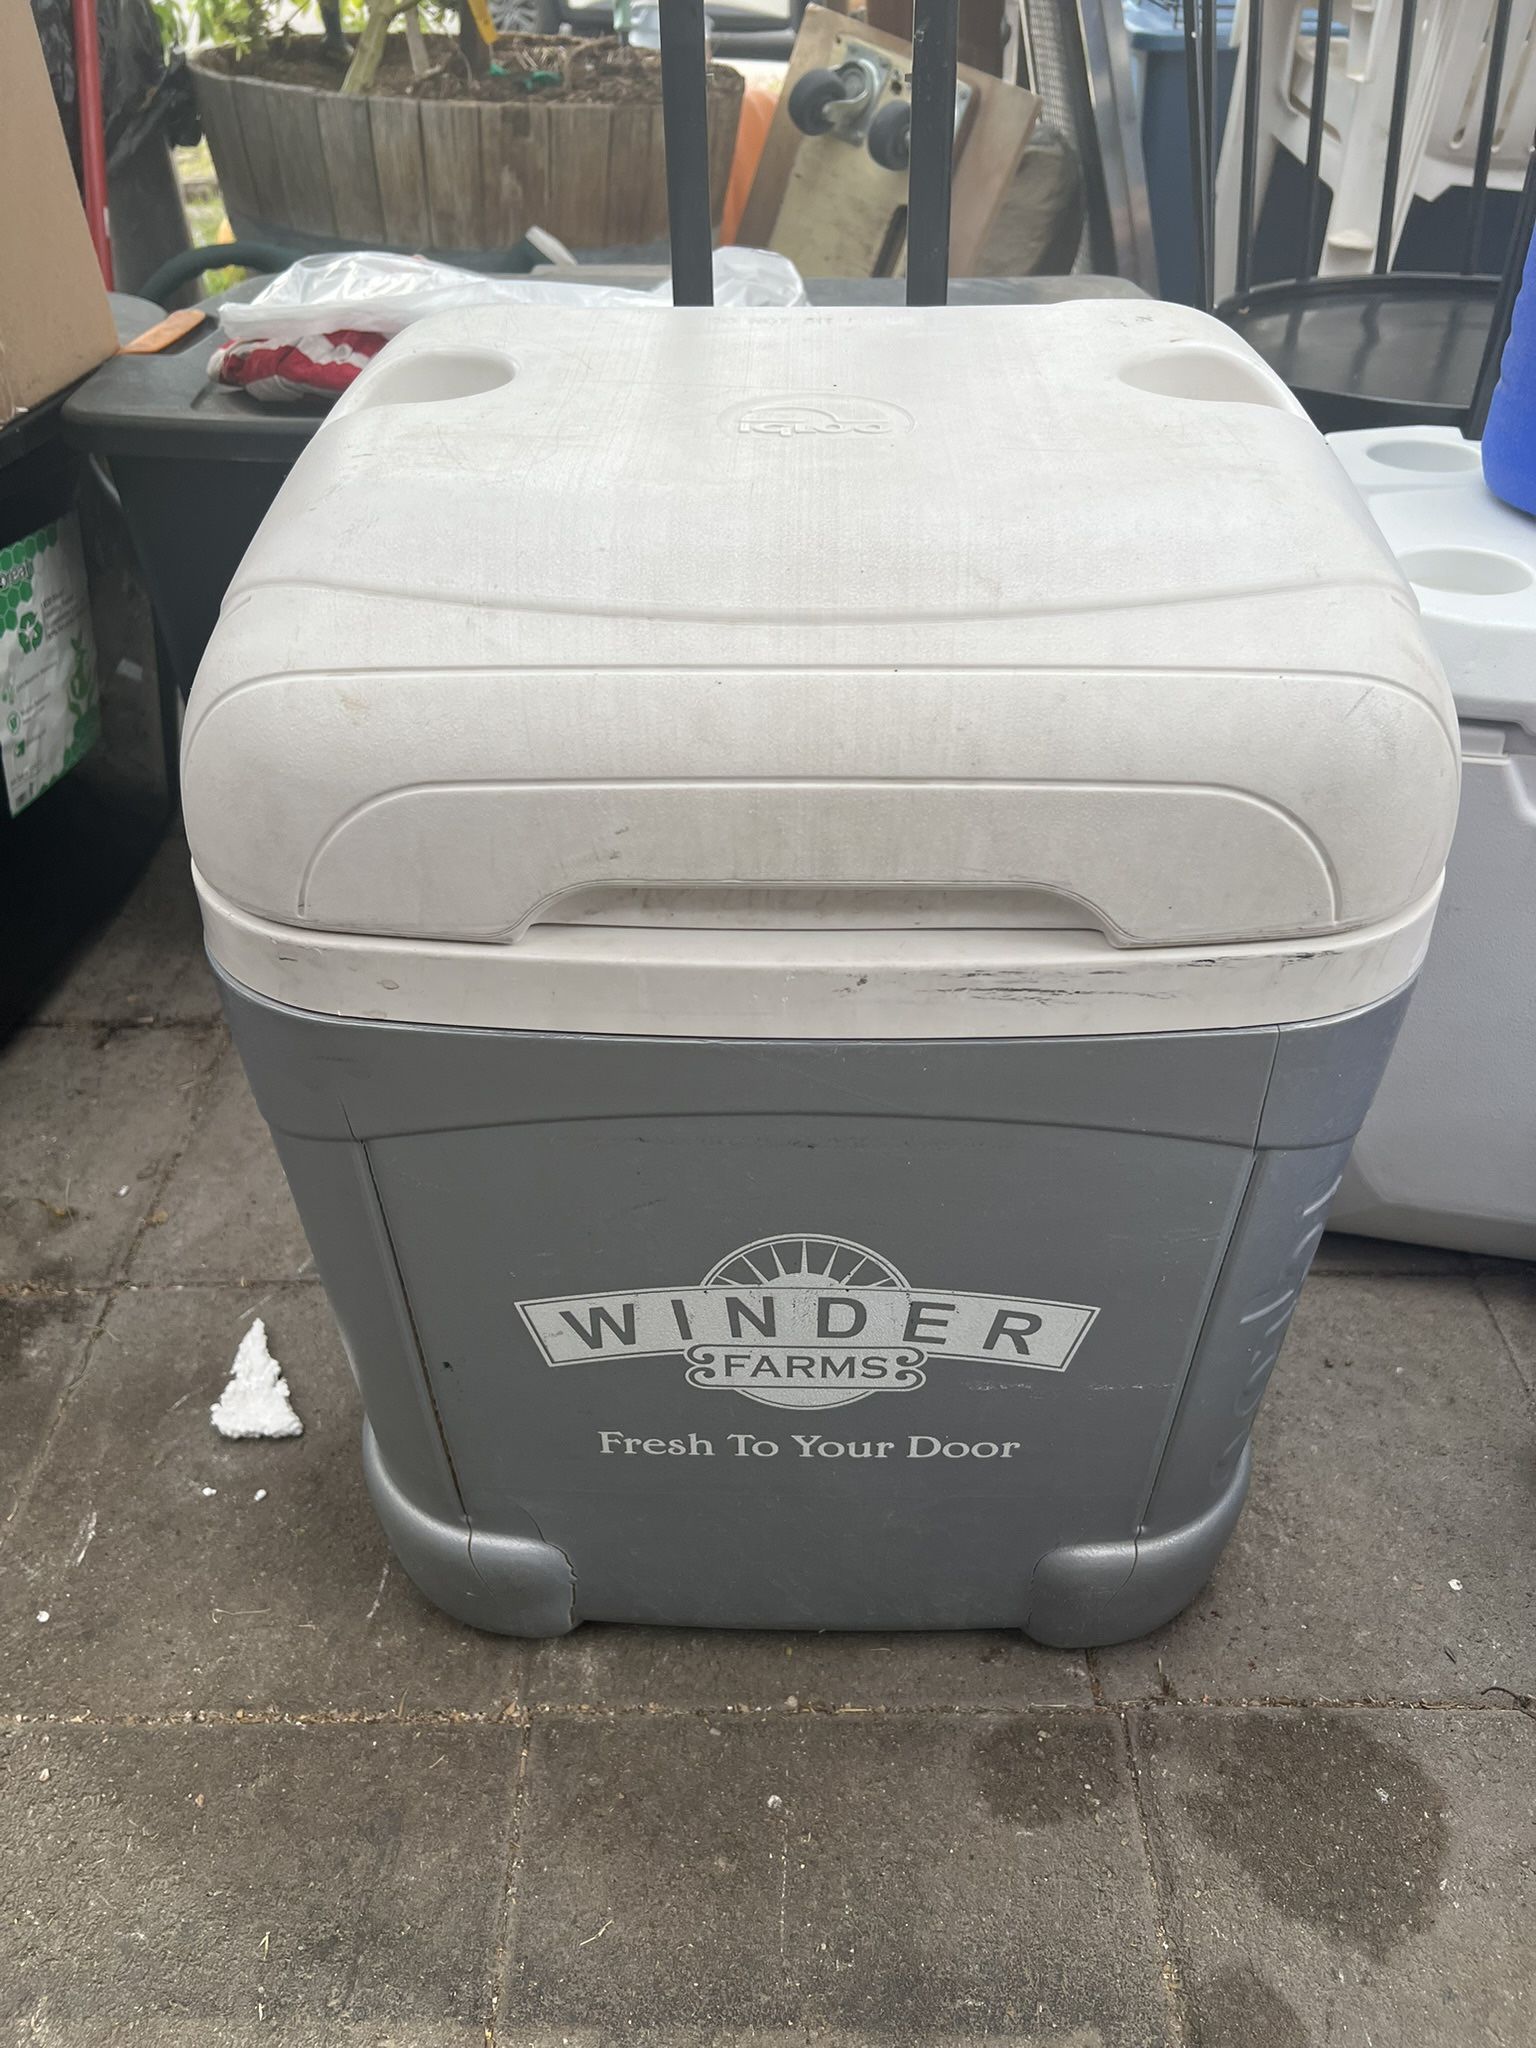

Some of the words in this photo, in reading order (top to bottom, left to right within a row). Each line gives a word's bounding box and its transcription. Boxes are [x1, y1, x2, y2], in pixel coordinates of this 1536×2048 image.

[559, 1296, 1043, 1356] WINDER
[724, 1354, 889, 1380] FARMS
[598, 1431, 716, 1456] Fresh
[727, 1433, 779, 1457] To
[791, 1434, 895, 1458] Your
[906, 1435, 1021, 1459] Door
